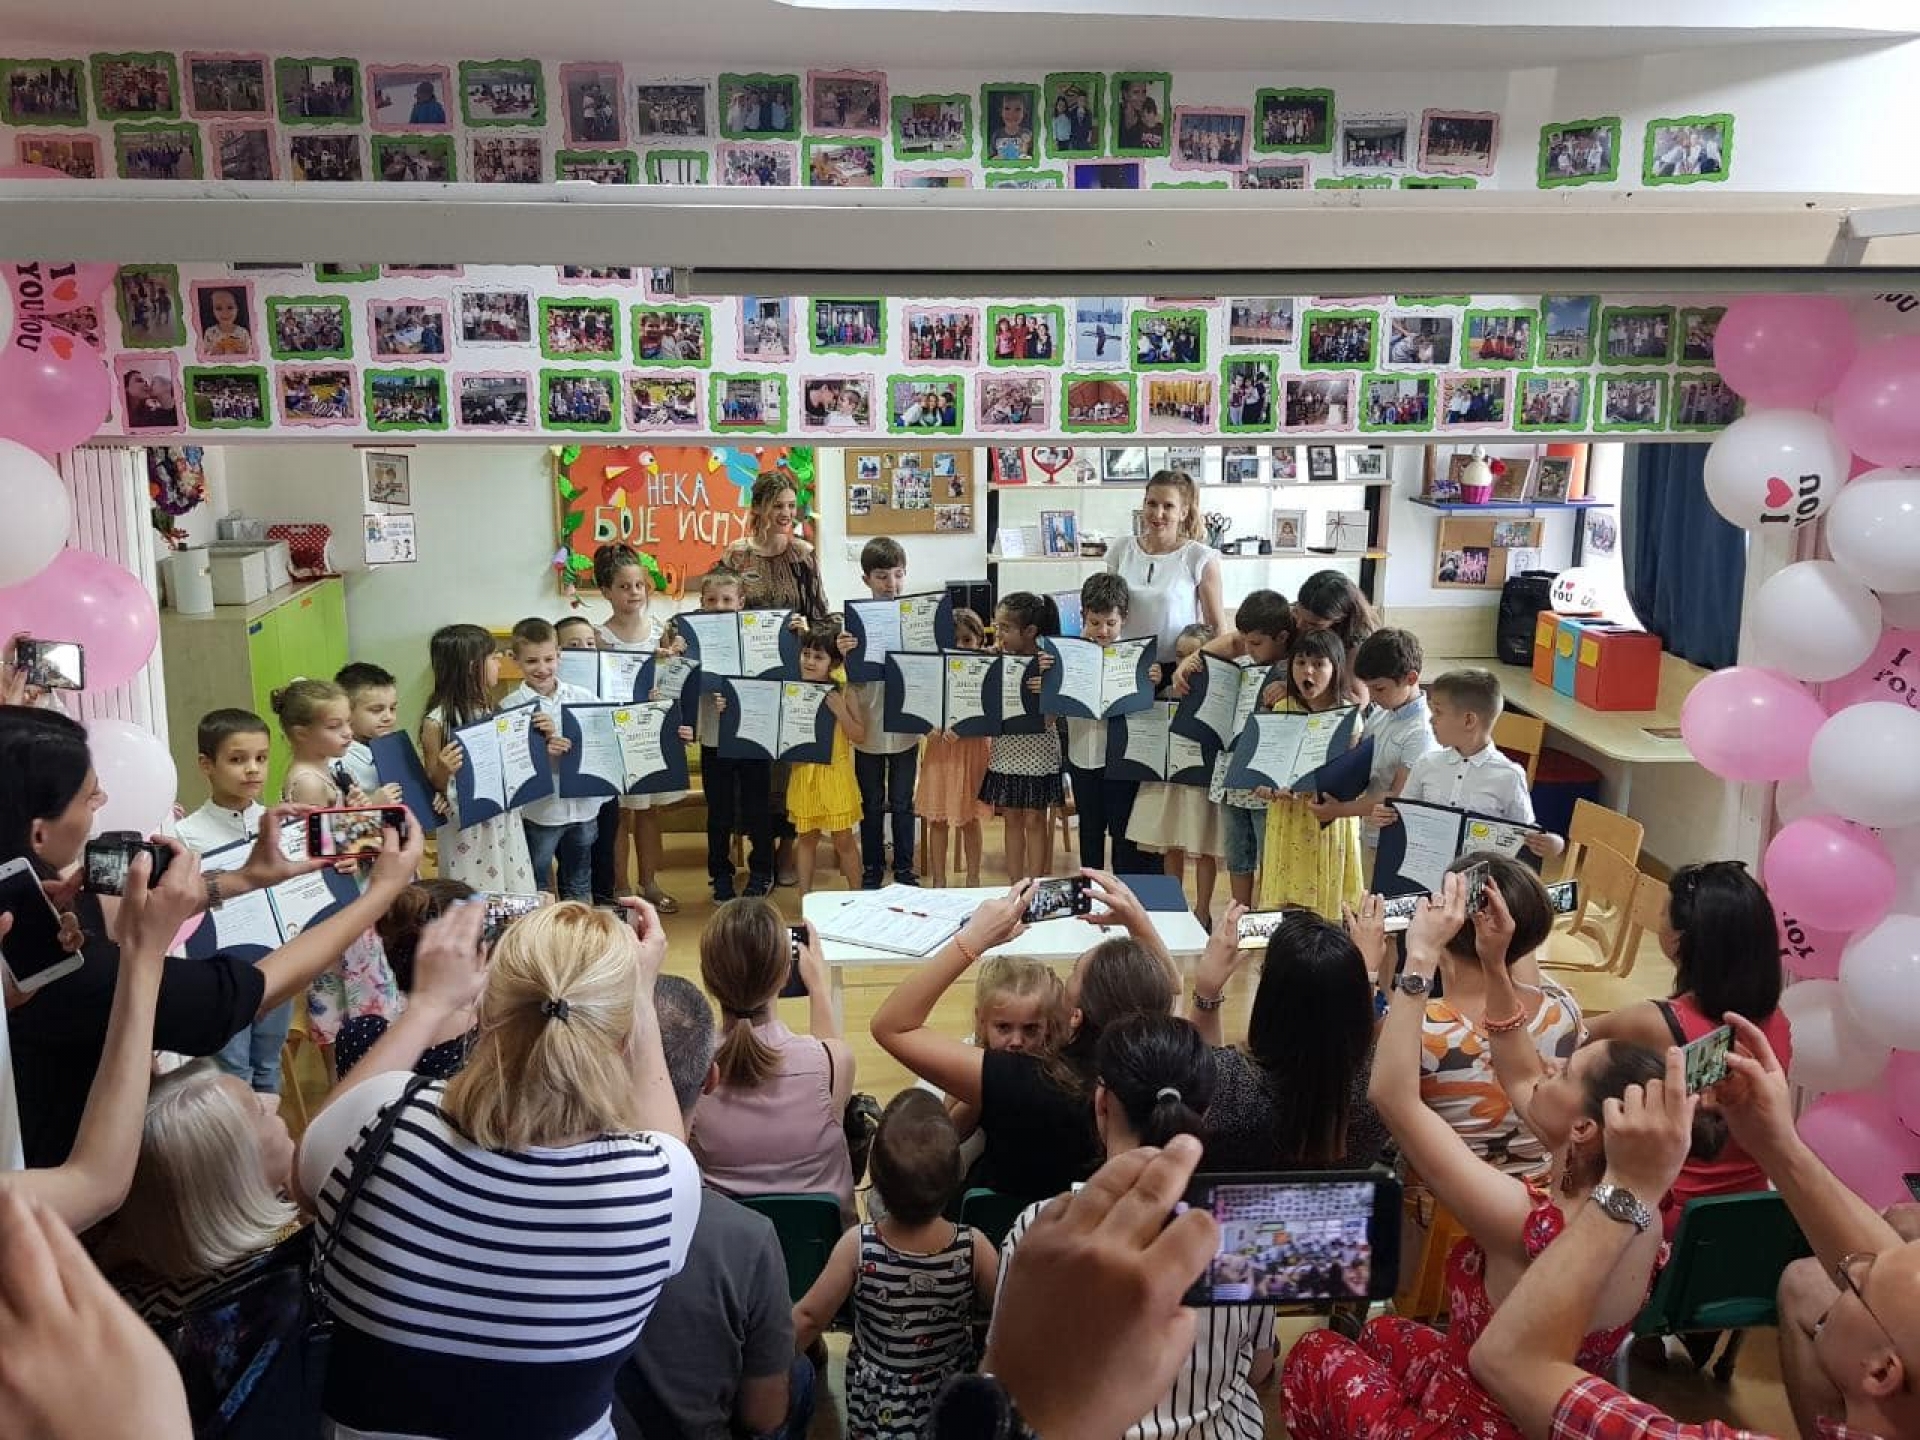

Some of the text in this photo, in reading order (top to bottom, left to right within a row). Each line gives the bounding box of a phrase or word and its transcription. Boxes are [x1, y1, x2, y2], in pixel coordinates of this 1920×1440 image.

[16, 262, 44, 311] YOU
[49, 262, 76, 280] I
[646, 471, 711, 506] НЕКА
[1793, 473, 1821, 528] YOU
[594, 504, 661, 547] БОЈЕ
[1760, 513, 1790, 524] I
[1553, 589, 1572, 601] YOU
[1891, 647, 1912, 667] I
[1872, 670, 1918, 709] YOU
